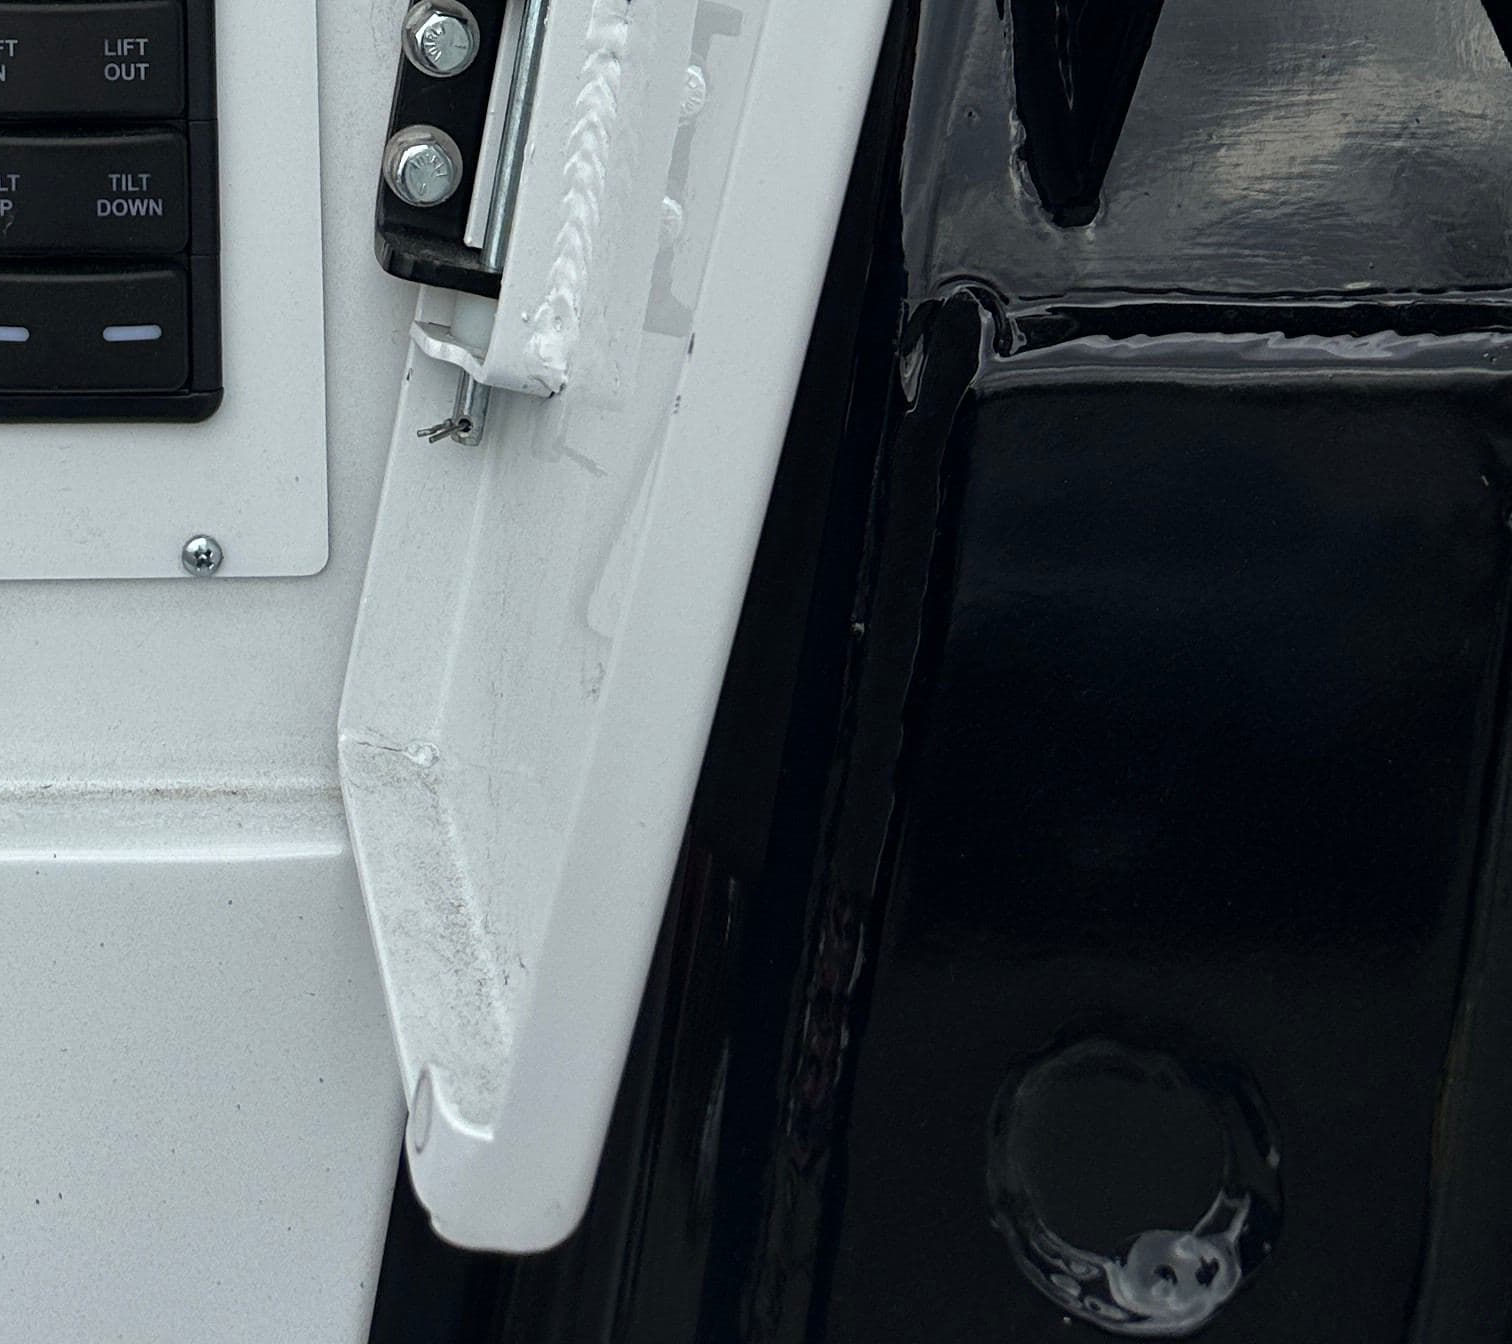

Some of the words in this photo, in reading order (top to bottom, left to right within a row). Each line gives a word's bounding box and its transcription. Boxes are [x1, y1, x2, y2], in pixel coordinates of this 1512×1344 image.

[103, 38, 150, 56] LIFT
[103, 63, 151, 81] OUT
[107, 173, 151, 192] TILT
[96, 198, 164, 217] DOWN
